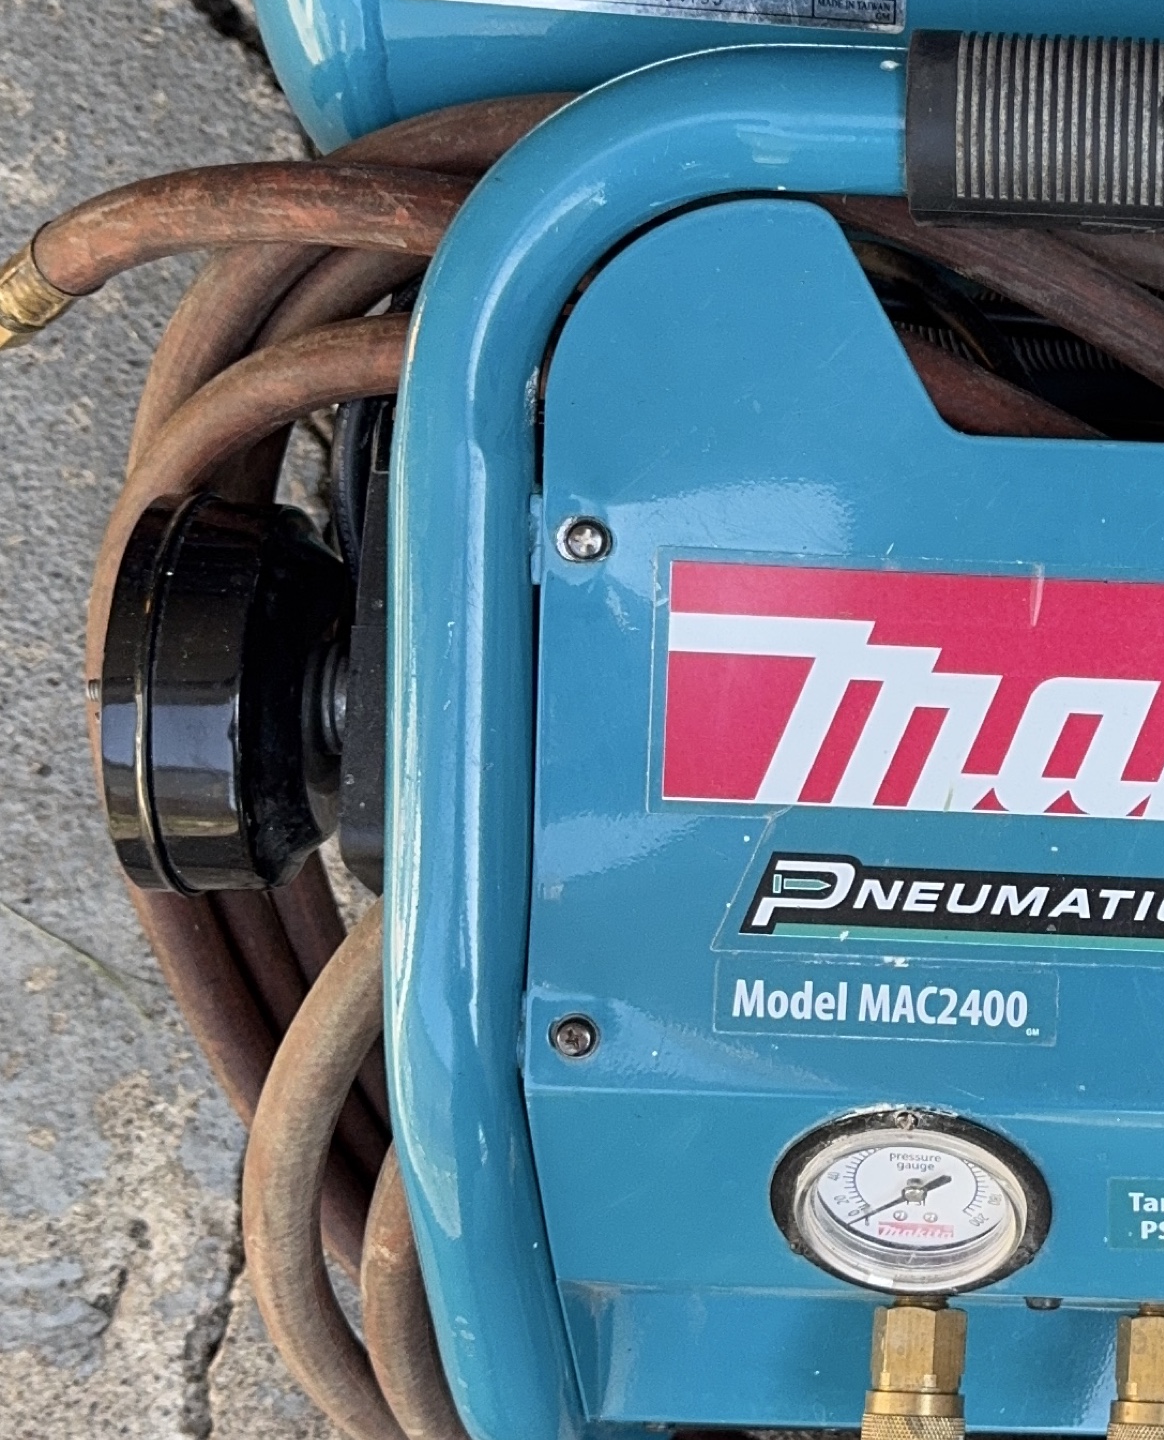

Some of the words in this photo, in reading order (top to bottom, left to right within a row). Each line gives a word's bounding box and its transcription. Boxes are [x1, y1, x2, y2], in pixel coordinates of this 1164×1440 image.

[845, 0, 856, 9] IN
[857, 0, 890, 11] TAIWAN
[732, 979, 847, 1021] Model
[858, 984, 1028, 1027] MAC2400
[889, 1152, 942, 1163] pressure
[896, 1161, 935, 1173] gauge
[968, 1213, 990, 1227] 200
